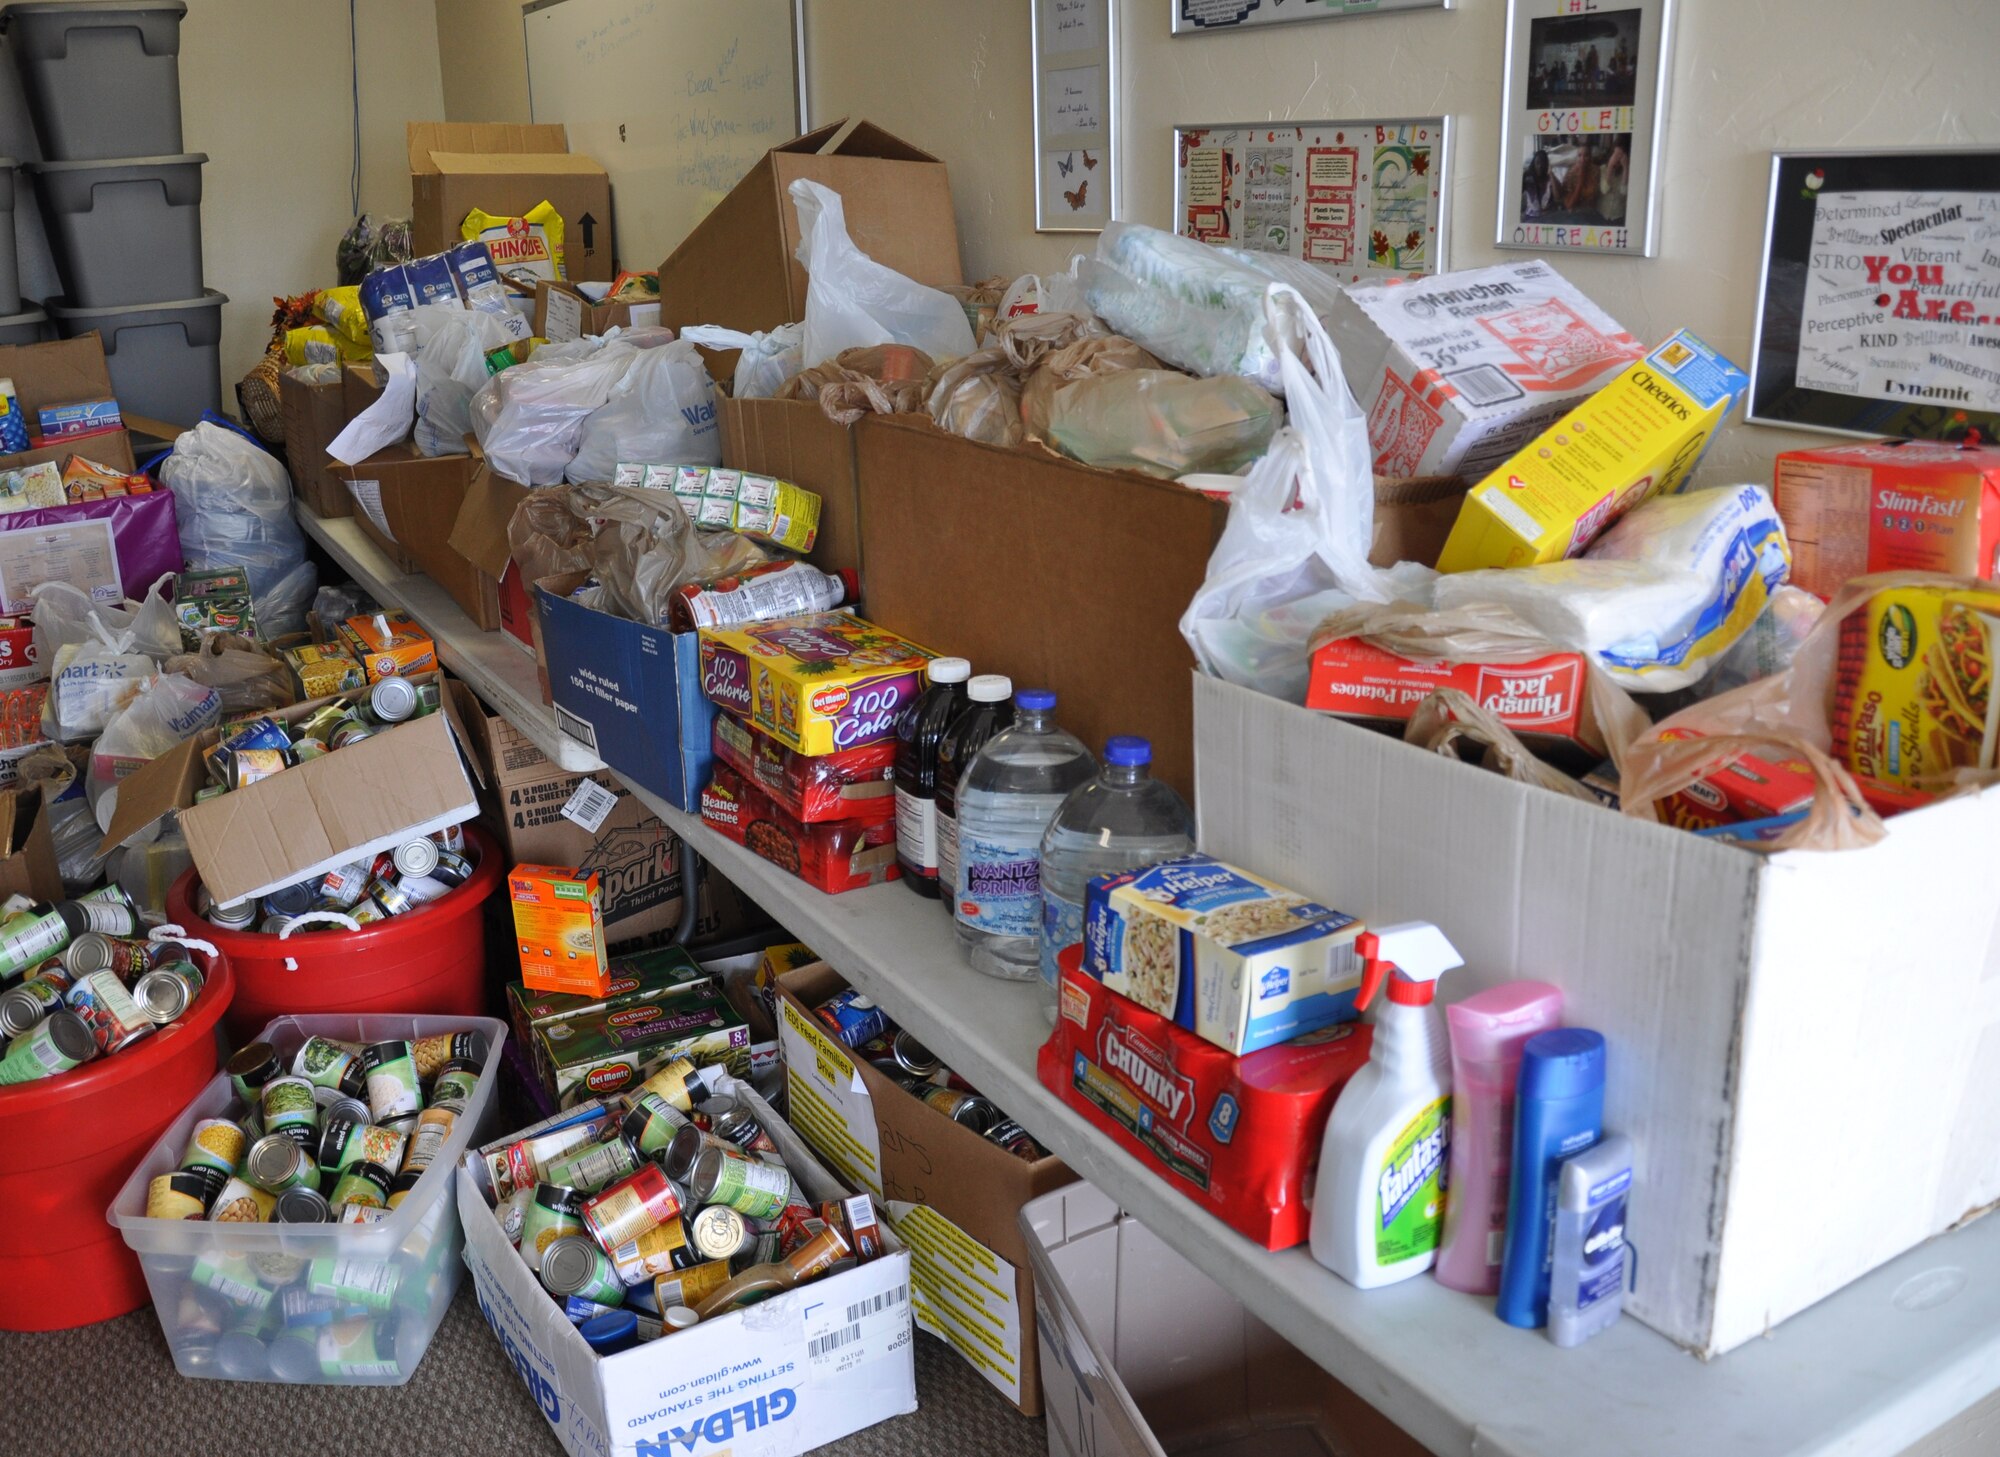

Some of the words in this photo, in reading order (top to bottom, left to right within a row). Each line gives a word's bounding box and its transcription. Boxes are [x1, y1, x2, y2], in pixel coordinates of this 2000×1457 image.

[1815, 201, 1901, 221] Determined
[1880, 203, 1963, 245] Spectacular
[490, 239, 543, 260] HINODE
[584, 250, 595, 258] JP
[1901, 247, 1962, 263] Vibrant
[477, 269, 492, 278] GRITS
[1863, 255, 1943, 285] You
[1909, 277, 2000, 304] Beautiful
[1807, 312, 1885, 334] Perceptive
[1448, 339, 1484, 355] PACK
[1860, 333, 1898, 348] KIND
[1631, 371, 1691, 421] Cheerios
[1884, 379, 1974, 402] Dynamic
[1502, 413, 1550, 432] Chicken
[714, 656, 737, 680] 100
[578, 667, 597, 682] wide
[598, 677, 619, 692] ruled
[705, 673, 751, 702] Calorie
[1502, 675, 1553, 695] Jack
[570, 675, 584, 689] 150
[585, 684, 594, 694] ct
[594, 687, 613, 702] filler
[615, 696, 638, 714] paper
[813, 695, 825, 708] Del
[825, 692, 847, 706] Monte
[851, 686, 899, 718] 100
[1331, 682, 1396, 704] Potatoes
[1483, 693, 1562, 717] Hungry
[1900, 702, 1924, 762] Shells
[754, 755, 784, 774] Beanee
[510, 790, 522, 806] 4
[531, 781, 558, 795] ROLLS
[524, 795, 537, 805] 48
[538, 788, 571, 803] SHEETS
[702, 793, 739, 813] Beanee
[514, 812, 525, 829] 4
[535, 803, 565, 817] ROLLO
[528, 817, 541, 827] 48
[541, 811, 568, 825] HOJA
[702, 806, 738, 826] Weenee
[971, 859, 1040, 880] NANTZ
[1166, 870, 1197, 882] Tuna
[1169, 871, 1235, 895] Helper
[631, 891, 656, 908] Thirst
[1093, 905, 1109, 956] Helper
[612, 1014, 626, 1024] Del
[627, 1009, 659, 1021] Monte
[678, 1011, 709, 1023] STYLE
[631, 1026, 667, 1038] GREEN
[669, 1018, 704, 1032] BEANS
[733, 1031, 742, 1043] 8
[784, 1006, 799, 1030] FEDS
[800, 1022, 817, 1046] Feed
[818, 1038, 849, 1075] Families
[1129, 1031, 1163, 1064] Campbell's
[753, 1060, 773, 1069] PRODUCT
[816, 1056, 836, 1084] Drive
[1077, 1060, 1085, 1075] 4
[589, 1073, 602, 1086] Del
[603, 1069, 629, 1083] Monte
[1105, 1032, 1185, 1121] CHUNKY
[1142, 1113, 1150, 1128] 4
[1218, 1102, 1233, 1127] 8
[336, 1132, 347, 1151] mixed
[551, 1203, 573, 1214] whole
[658, 1356, 762, 1400] www.gildan.com
[737, 1361, 796, 1390] SETTING
[707, 1384, 735, 1401] THE
[627, 1394, 704, 1429] STANDARD
[635, 1387, 797, 1457] GILDAN
